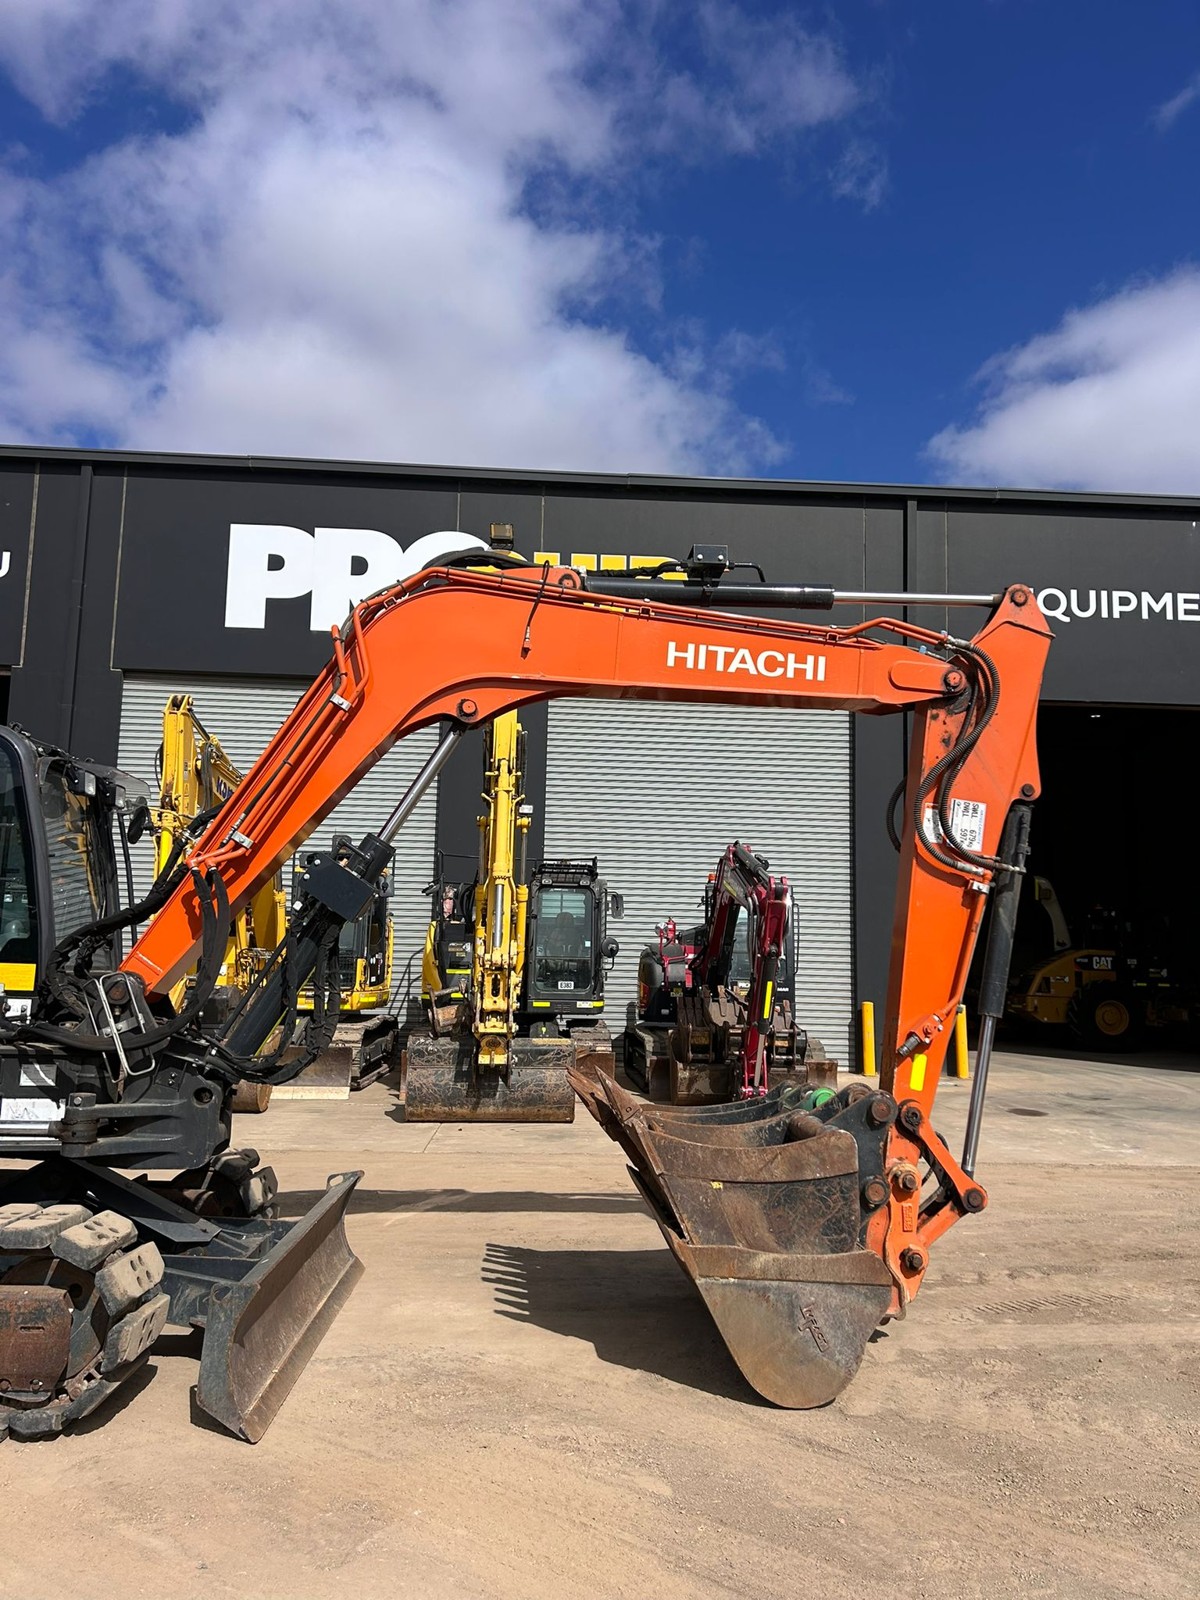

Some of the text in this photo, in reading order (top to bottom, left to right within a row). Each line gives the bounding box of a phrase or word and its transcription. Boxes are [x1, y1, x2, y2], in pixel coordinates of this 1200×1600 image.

[1029, 587, 1200, 623] QUIPME
[666, 641, 827, 682] HITACHI
[1092, 956, 1113, 970] CAT
